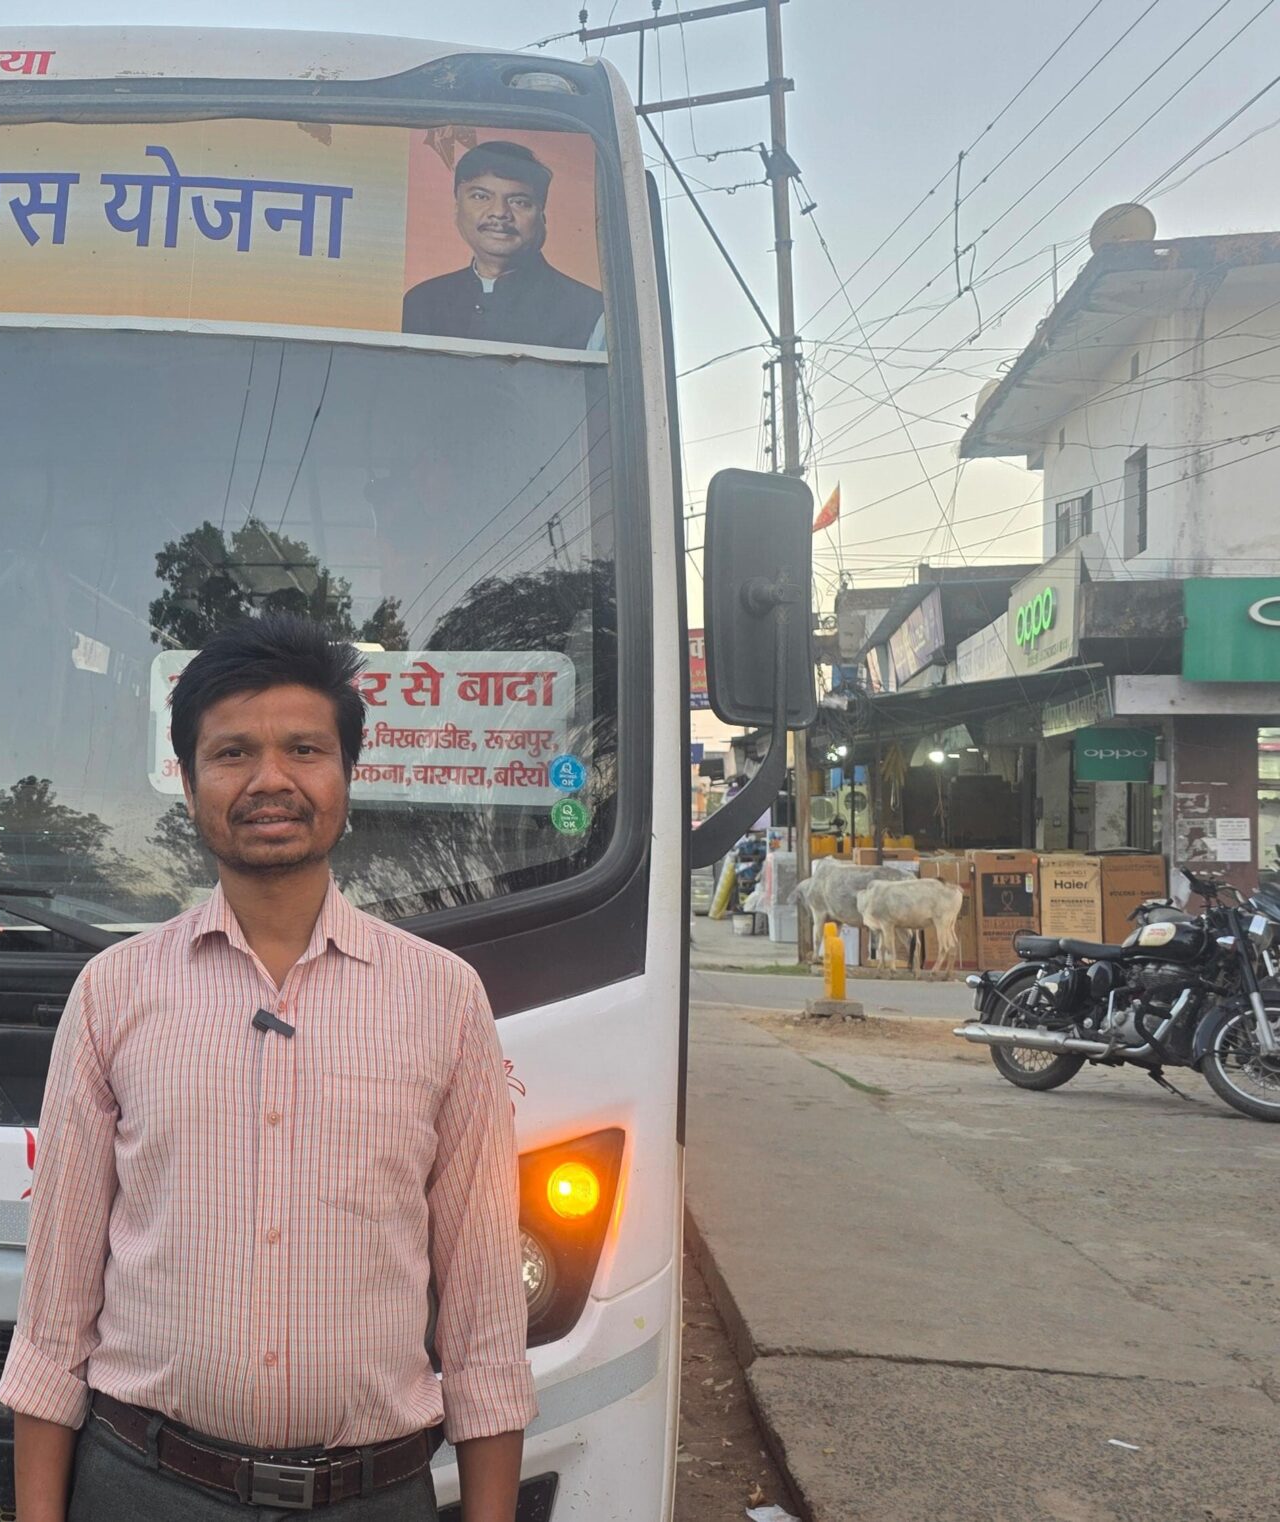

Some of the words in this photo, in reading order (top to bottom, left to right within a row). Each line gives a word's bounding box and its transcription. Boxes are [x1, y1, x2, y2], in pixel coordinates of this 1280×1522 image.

[100, 145, 354, 259] योजना
[1015, 586, 1054, 650] oppo
[400, 661, 445, 707] से
[457, 670, 559, 707] बादा
[1083, 748, 1148, 760] oppo
[1053, 879, 1089, 890] Haier
